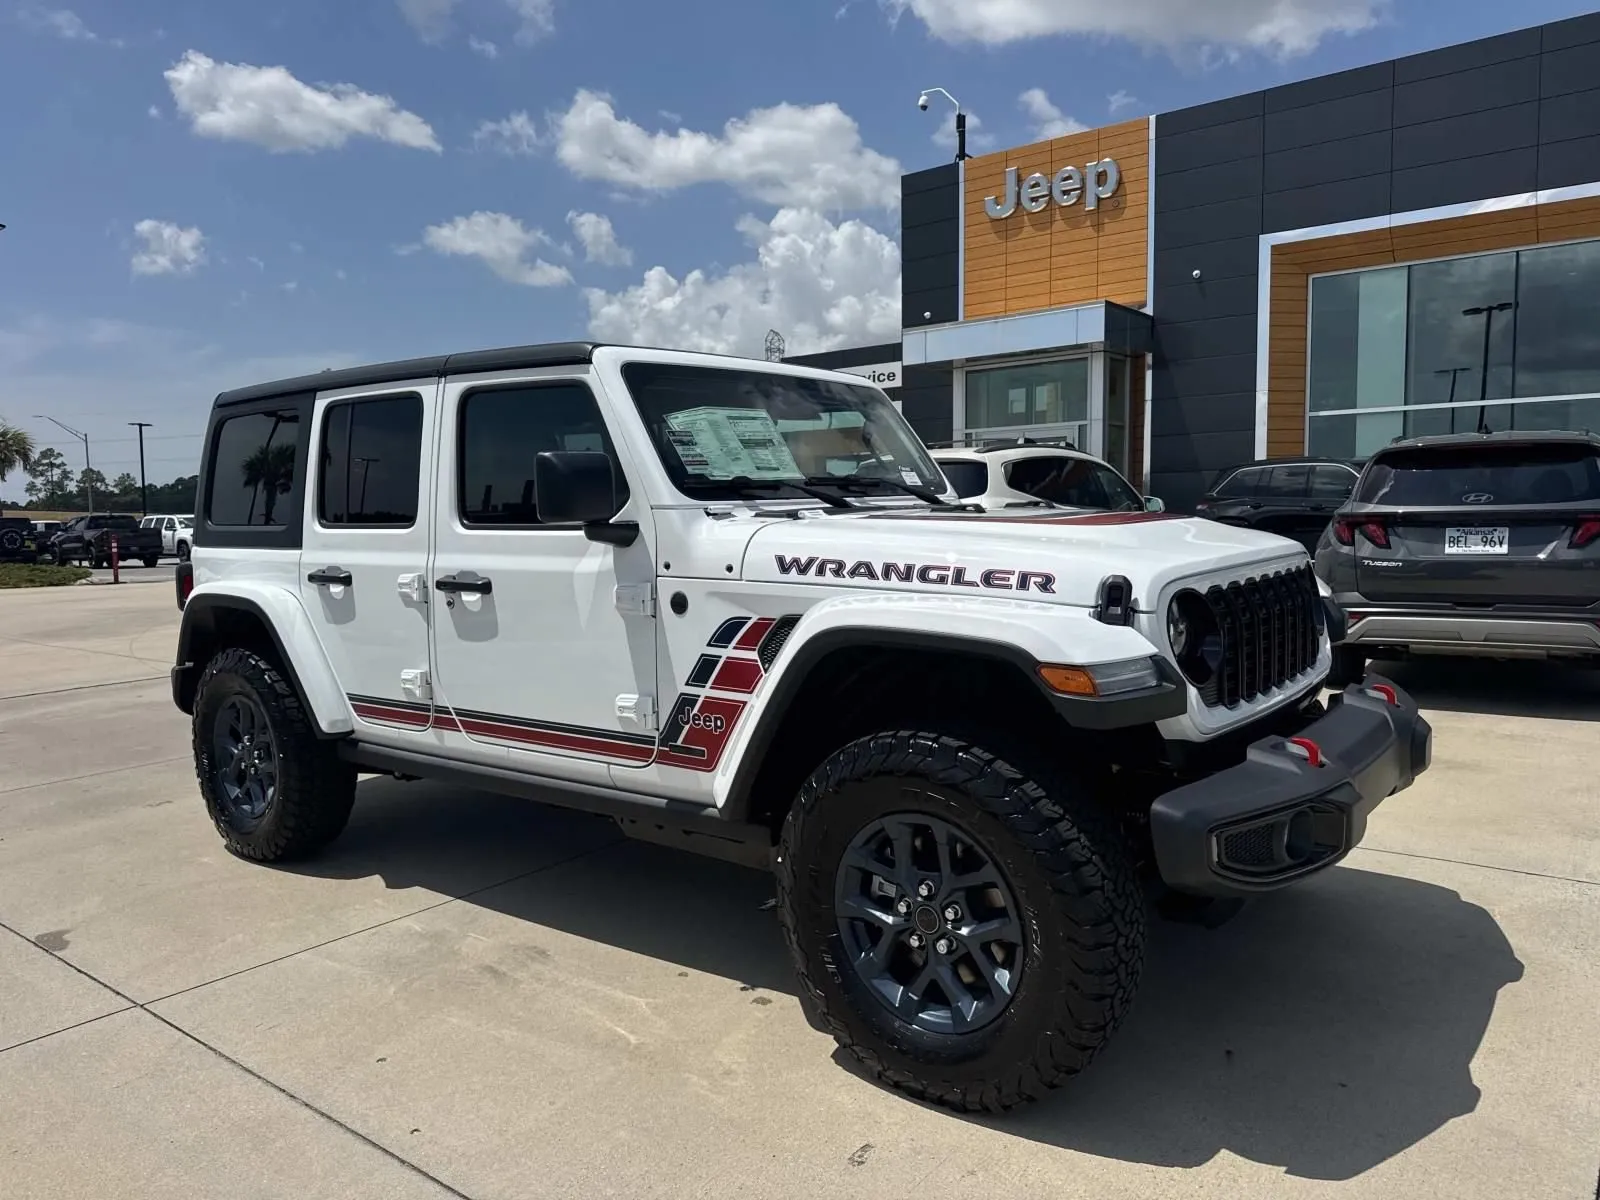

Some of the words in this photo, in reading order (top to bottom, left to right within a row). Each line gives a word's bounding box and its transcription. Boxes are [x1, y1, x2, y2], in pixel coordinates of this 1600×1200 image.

[984, 158, 1121, 220] Jeep
[1448, 535, 1472, 548] BEL
[1481, 535, 1505, 548] 96V
[774, 554, 1057, 594] WRANGLER
[678, 706, 726, 735] Jeep
